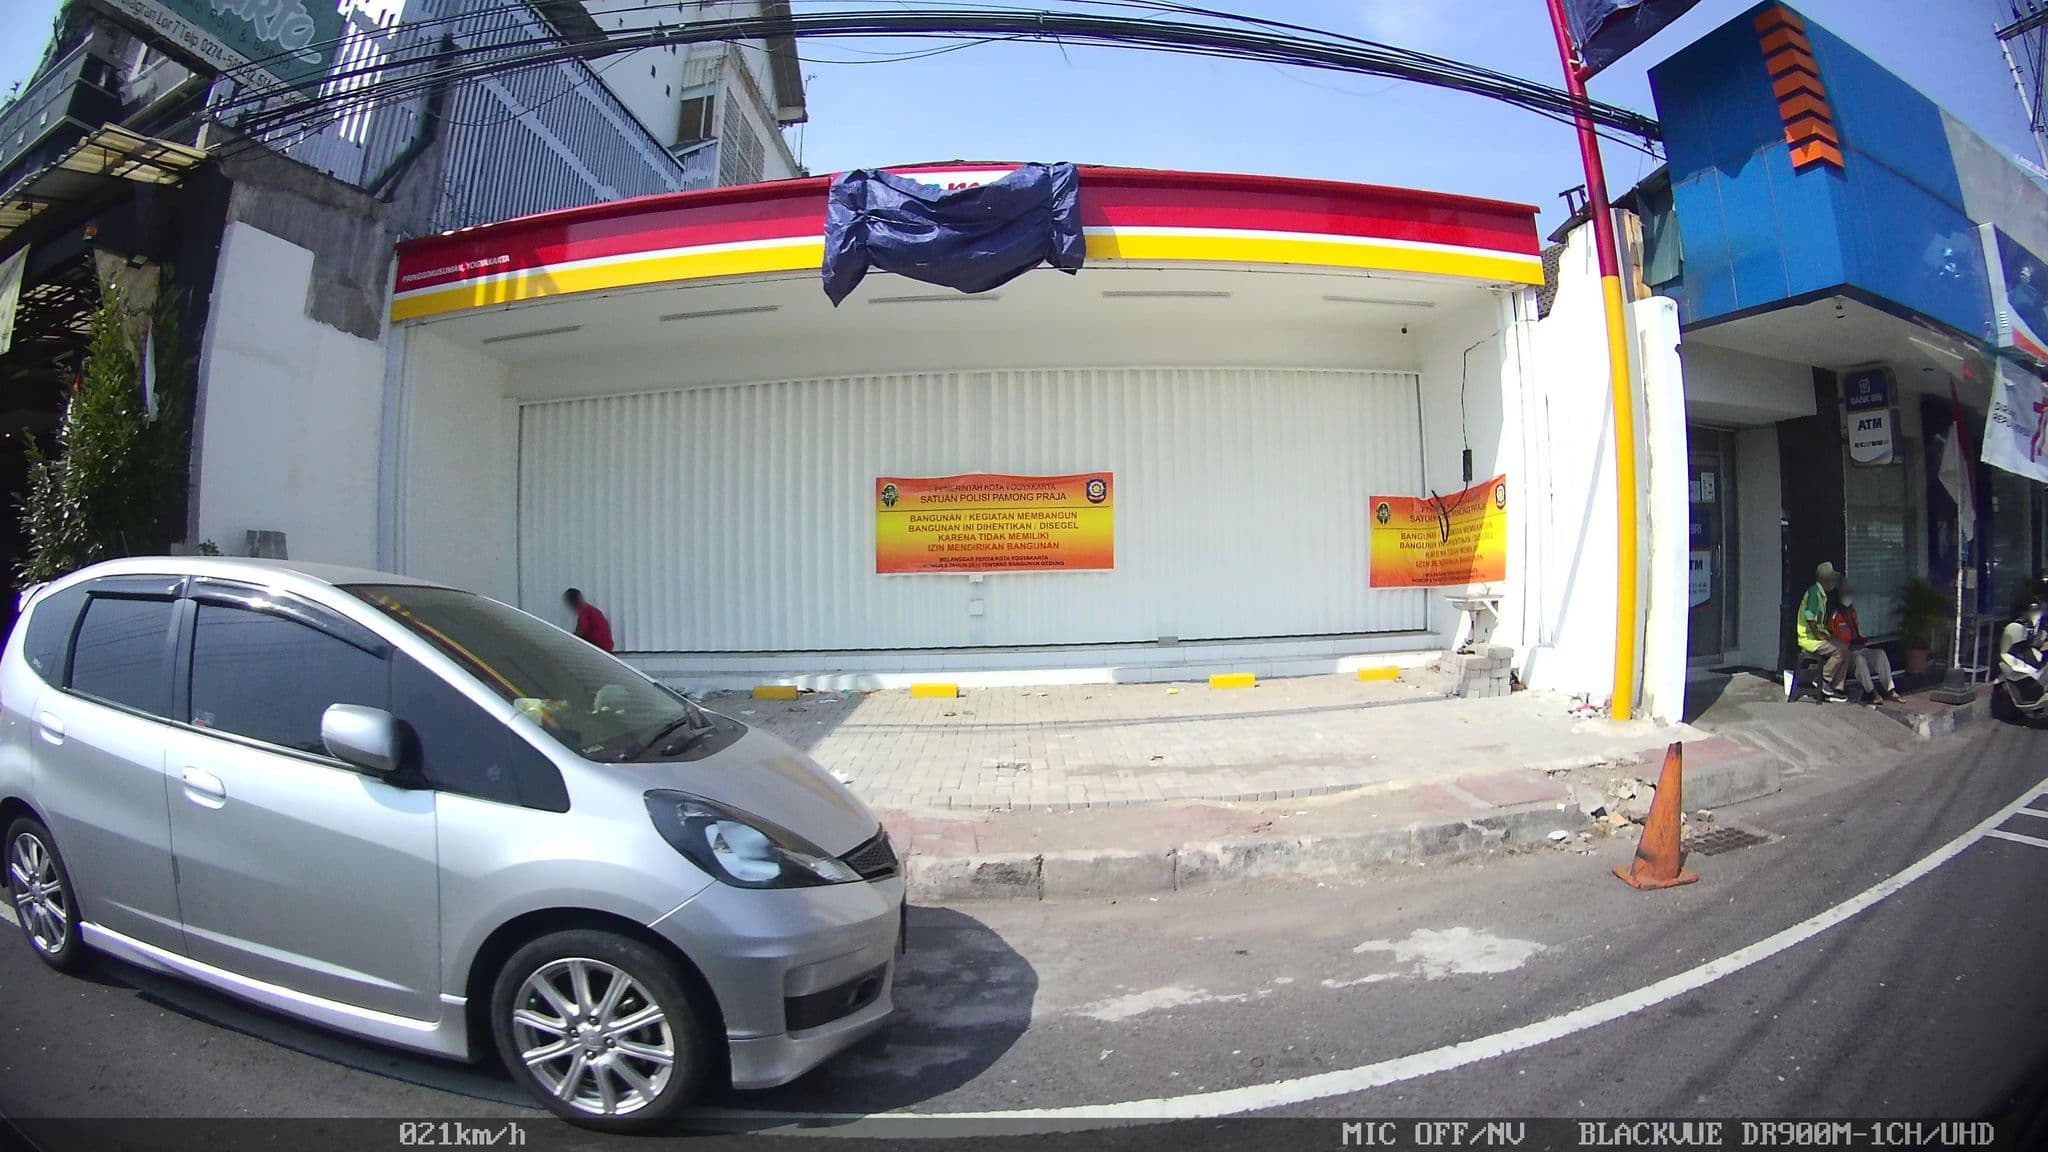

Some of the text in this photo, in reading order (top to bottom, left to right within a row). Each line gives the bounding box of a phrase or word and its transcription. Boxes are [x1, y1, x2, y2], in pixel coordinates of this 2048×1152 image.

[1858, 417, 1883, 432] ATM
[984, 483, 1005, 491] KOTA
[1006, 483, 1057, 491] YOGYAKARTA
[920, 492, 1067, 504] SATUAN POLISI PAMONG PRAJA
[909, 513, 961, 523] BANGUNAN
[969, 512, 1015, 522] KEGIATAN
[1017, 511, 1078, 520] MEMBANGUN
[908, 523, 960, 533] BANGUNAN
[962, 523, 974, 531] INI
[976, 522, 1032, 531] DIHENTIKAN
[1039, 521, 1079, 530] DISEGEL
[938, 531, 1049, 542] KARENA TIDAK MEMILIKI
[927, 541, 1060, 552] IZIN MENDIRIKAN BANGUNAN
